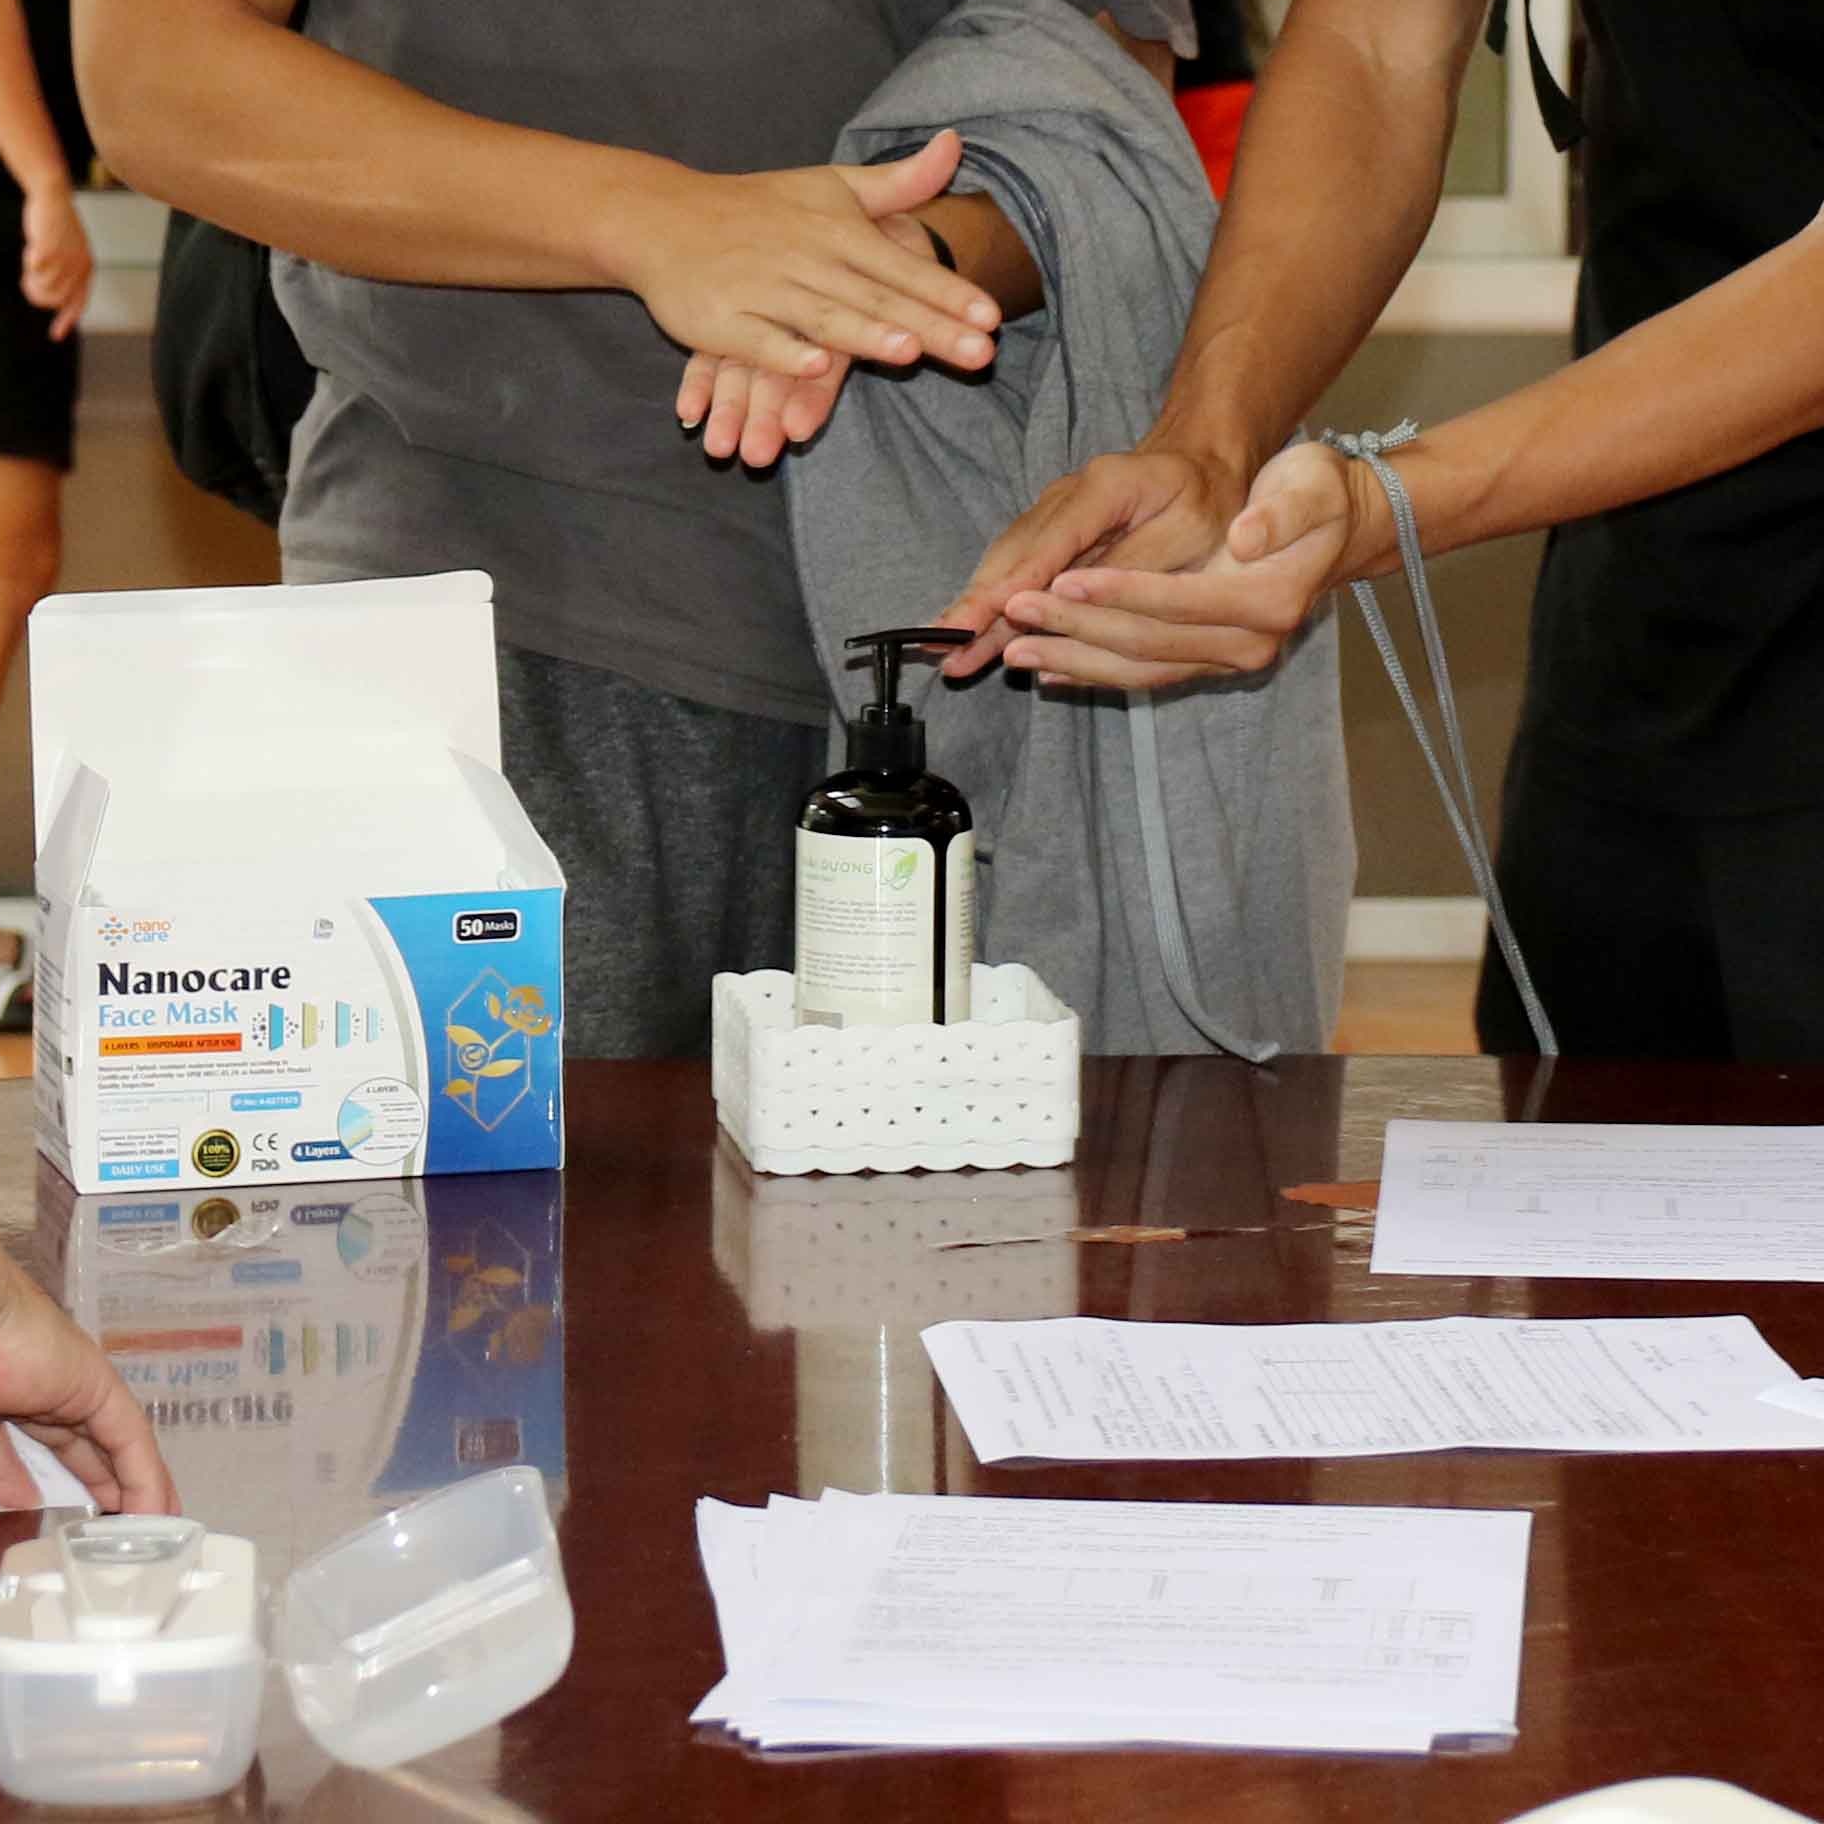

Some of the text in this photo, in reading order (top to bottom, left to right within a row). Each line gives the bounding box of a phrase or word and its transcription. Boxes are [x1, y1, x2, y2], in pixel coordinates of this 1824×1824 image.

[132, 919, 171, 932] nano
[460, 919, 515, 936] 50 Masks
[132, 931, 169, 943] care
[97, 963, 292, 995] Nanocare
[97, 1000, 239, 1027] Face Mask
[294, 1143, 341, 1158] 4 Layers
[112, 1162, 166, 1177] DAILY USE
